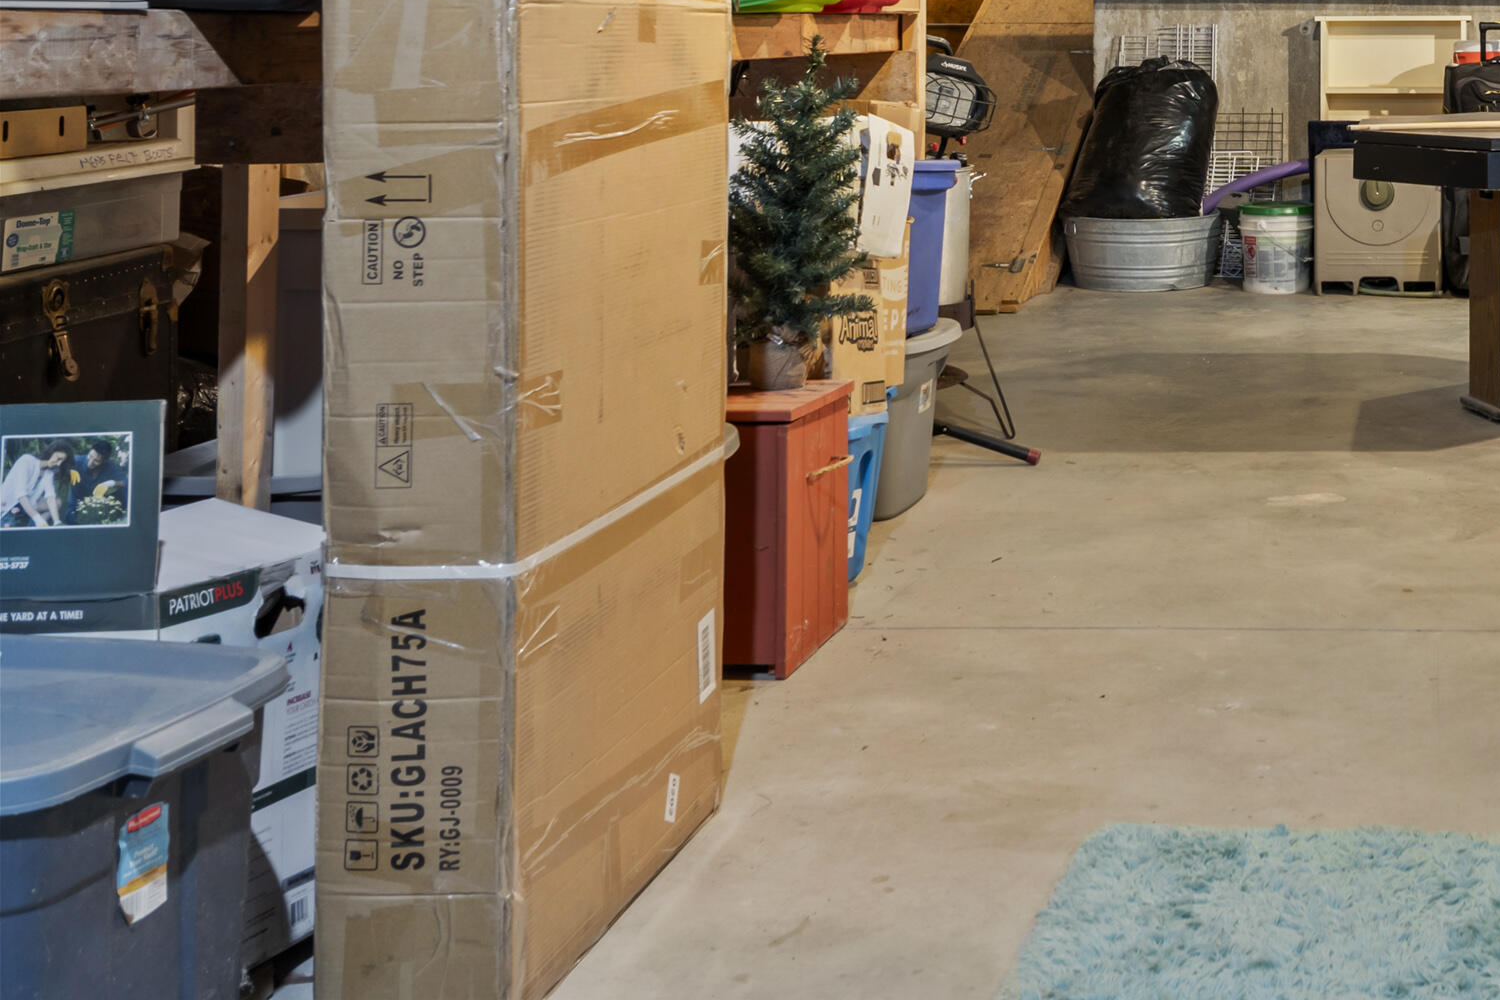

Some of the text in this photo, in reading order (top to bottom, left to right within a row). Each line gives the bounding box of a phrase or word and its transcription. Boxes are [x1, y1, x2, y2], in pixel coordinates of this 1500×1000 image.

[366, 223, 380, 281] CAUTION
[393, 260, 404, 280] NO
[412, 252, 424, 287] STEP
[839, 308, 879, 345] Animal
[10, 611, 34, 621] YARD
[36, 611, 48, 620] AT
[50, 611, 58, 620] A
[390, 609, 428, 871] SKU:GLACH75A
[439, 766, 463, 871] RY:GJ-0009
